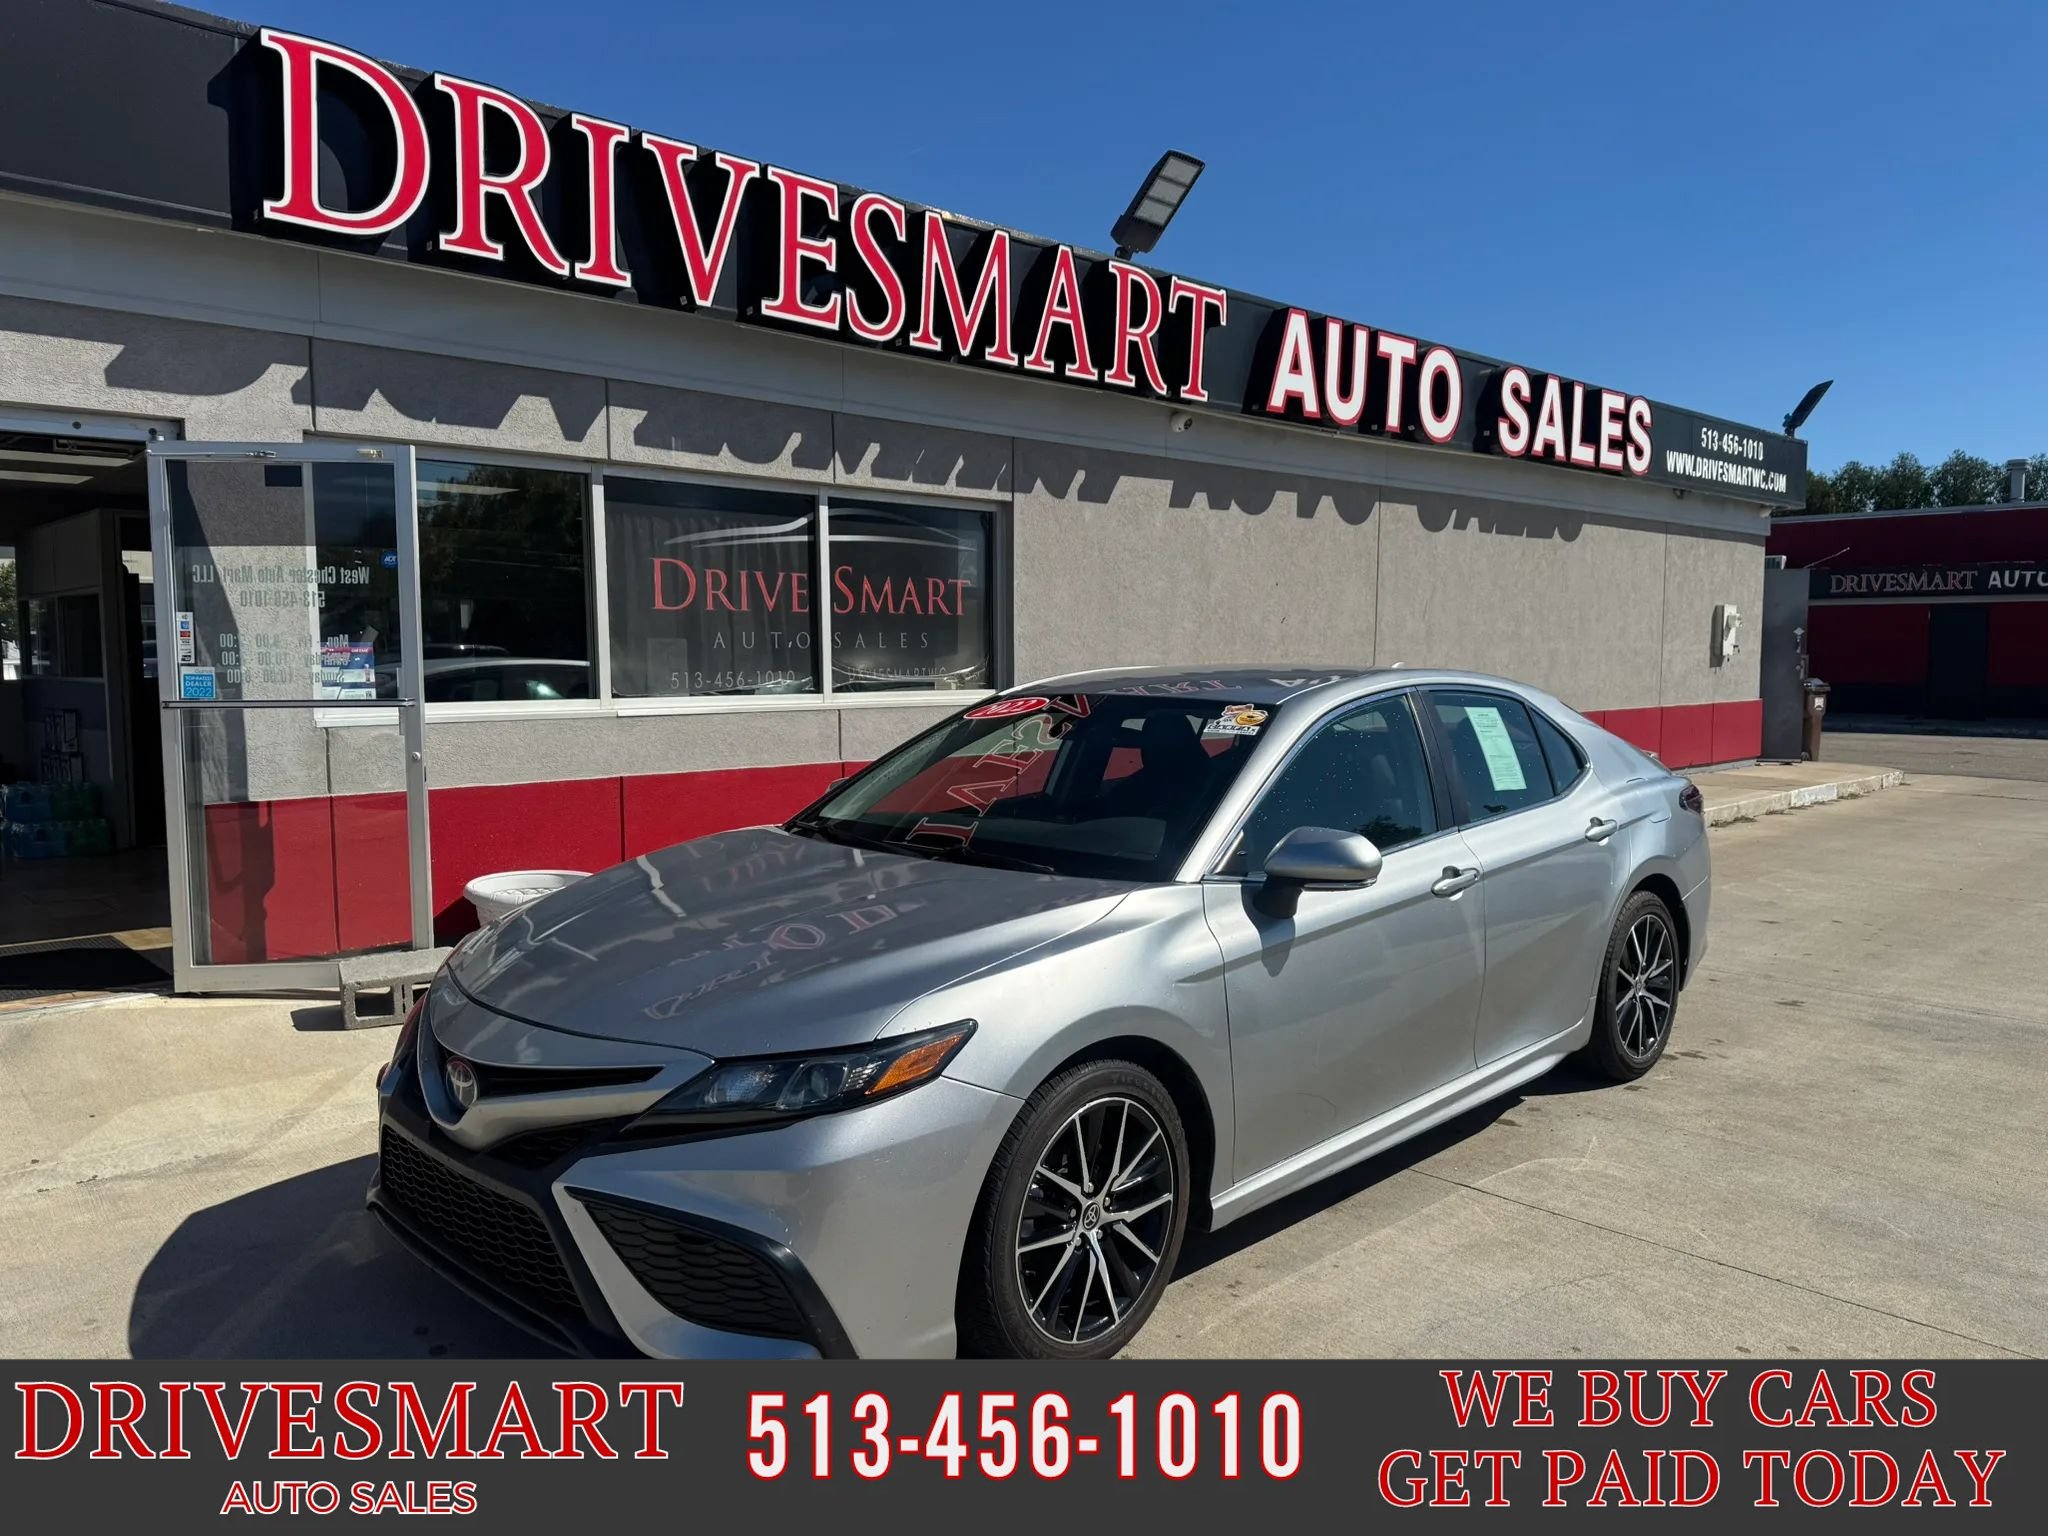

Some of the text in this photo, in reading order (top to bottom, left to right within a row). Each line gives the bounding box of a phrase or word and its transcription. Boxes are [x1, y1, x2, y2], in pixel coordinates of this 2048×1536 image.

[260, 27, 1653, 477] DRIVESMART AUTO SALES
[1700, 427, 1765, 462] 513-456-1010
[1666, 450, 1788, 494] WWW.DRIVESMARTWC.COM
[649, 557, 972, 616] DRIVE SMART
[1830, 569, 1979, 593] DRIVESMART
[713, 631, 930, 650] AUTO SALES
[185, 687, 212, 697] 2022
[670, 670, 797, 689] 513-456-1010
